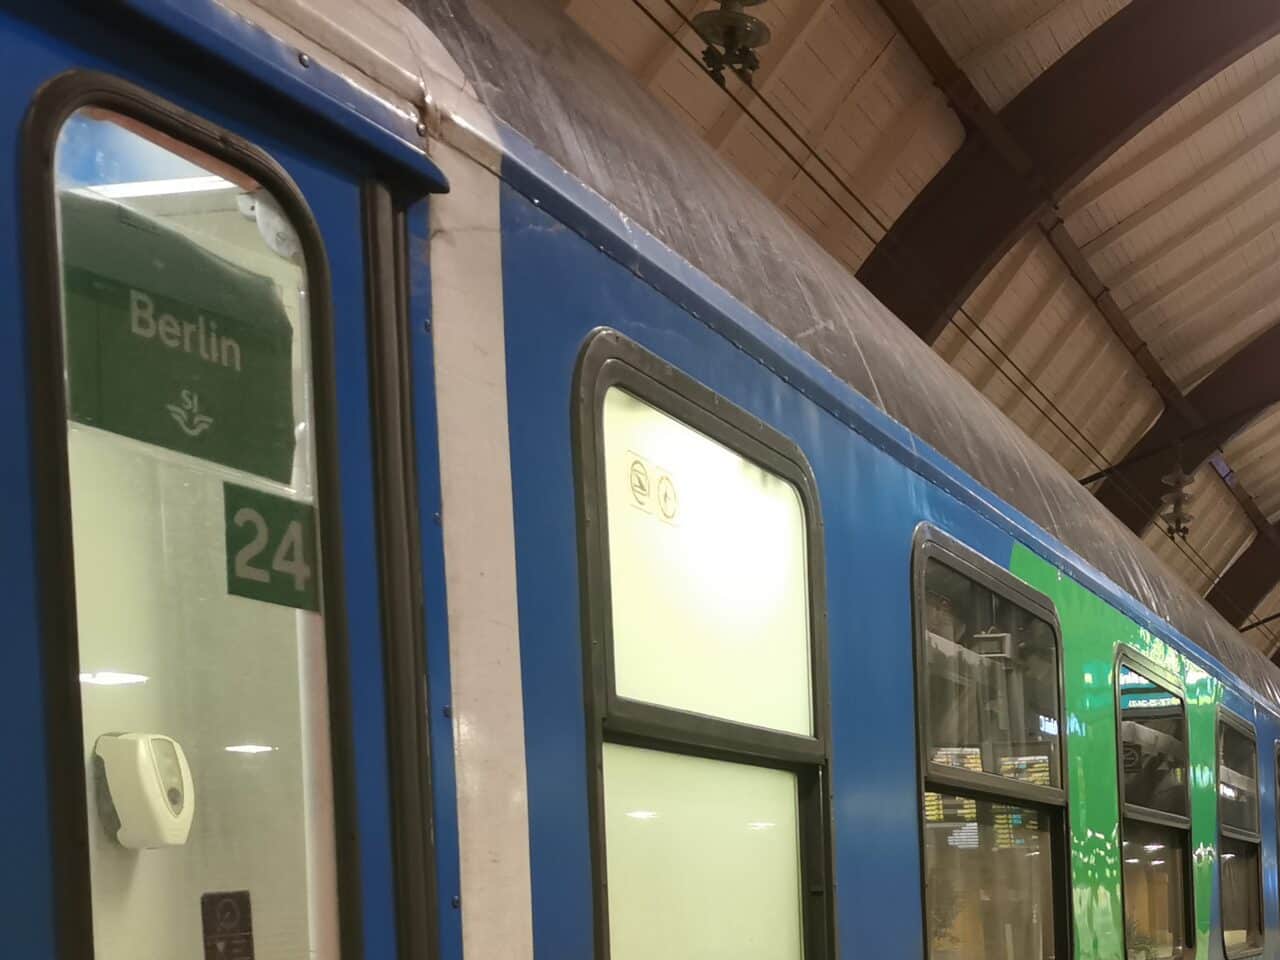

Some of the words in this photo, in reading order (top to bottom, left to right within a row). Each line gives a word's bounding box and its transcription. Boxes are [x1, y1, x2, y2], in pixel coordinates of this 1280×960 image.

[128, 288, 243, 373] Berlin
[181, 389, 199, 413] SJ
[233, 507, 312, 592] 24
